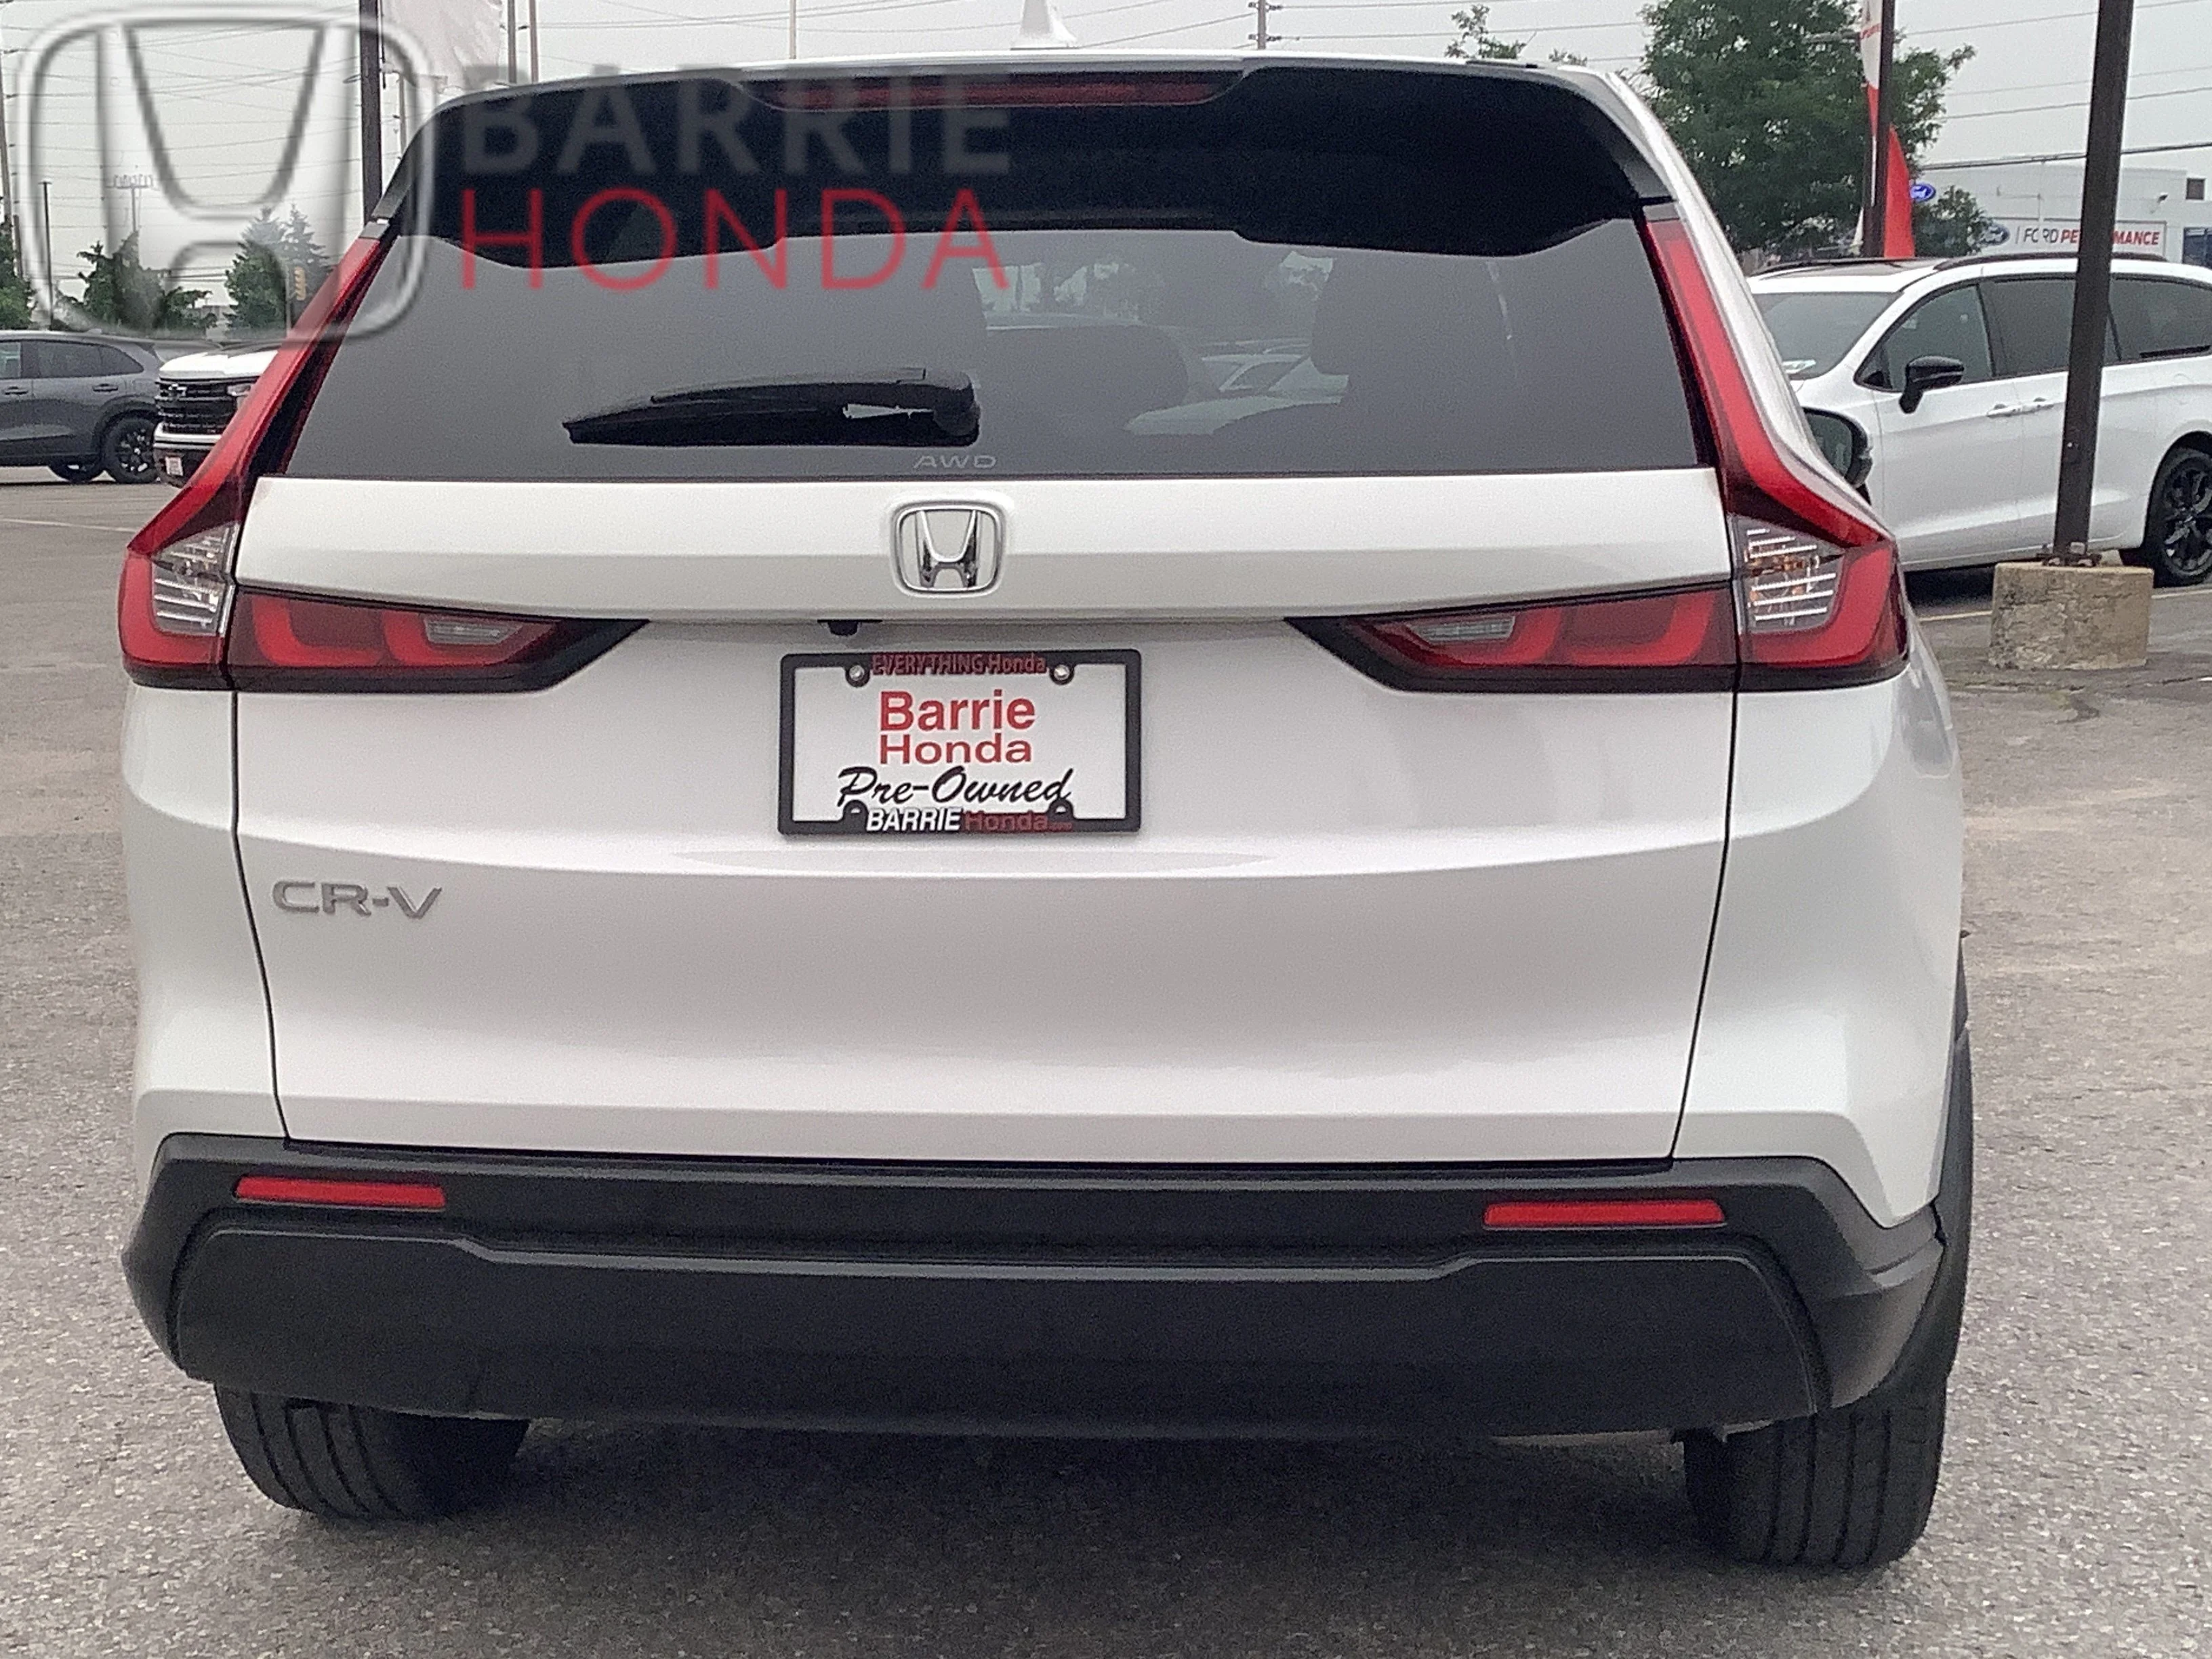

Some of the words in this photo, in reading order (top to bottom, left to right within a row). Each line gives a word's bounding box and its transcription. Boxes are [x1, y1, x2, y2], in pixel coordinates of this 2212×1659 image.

[2060, 229, 2160, 246] PEMANCE
[914, 455, 996, 468] AWD
[872, 653, 985, 674] EVERYTHING
[987, 653, 1048, 673] Honda
[880, 689, 1036, 731] Barrie
[880, 733, 1031, 764] Honda
[837, 765, 1074, 806] Pre-Owned
[866, 808, 963, 832] BARRIE
[272, 881, 442, 918] CR-V
